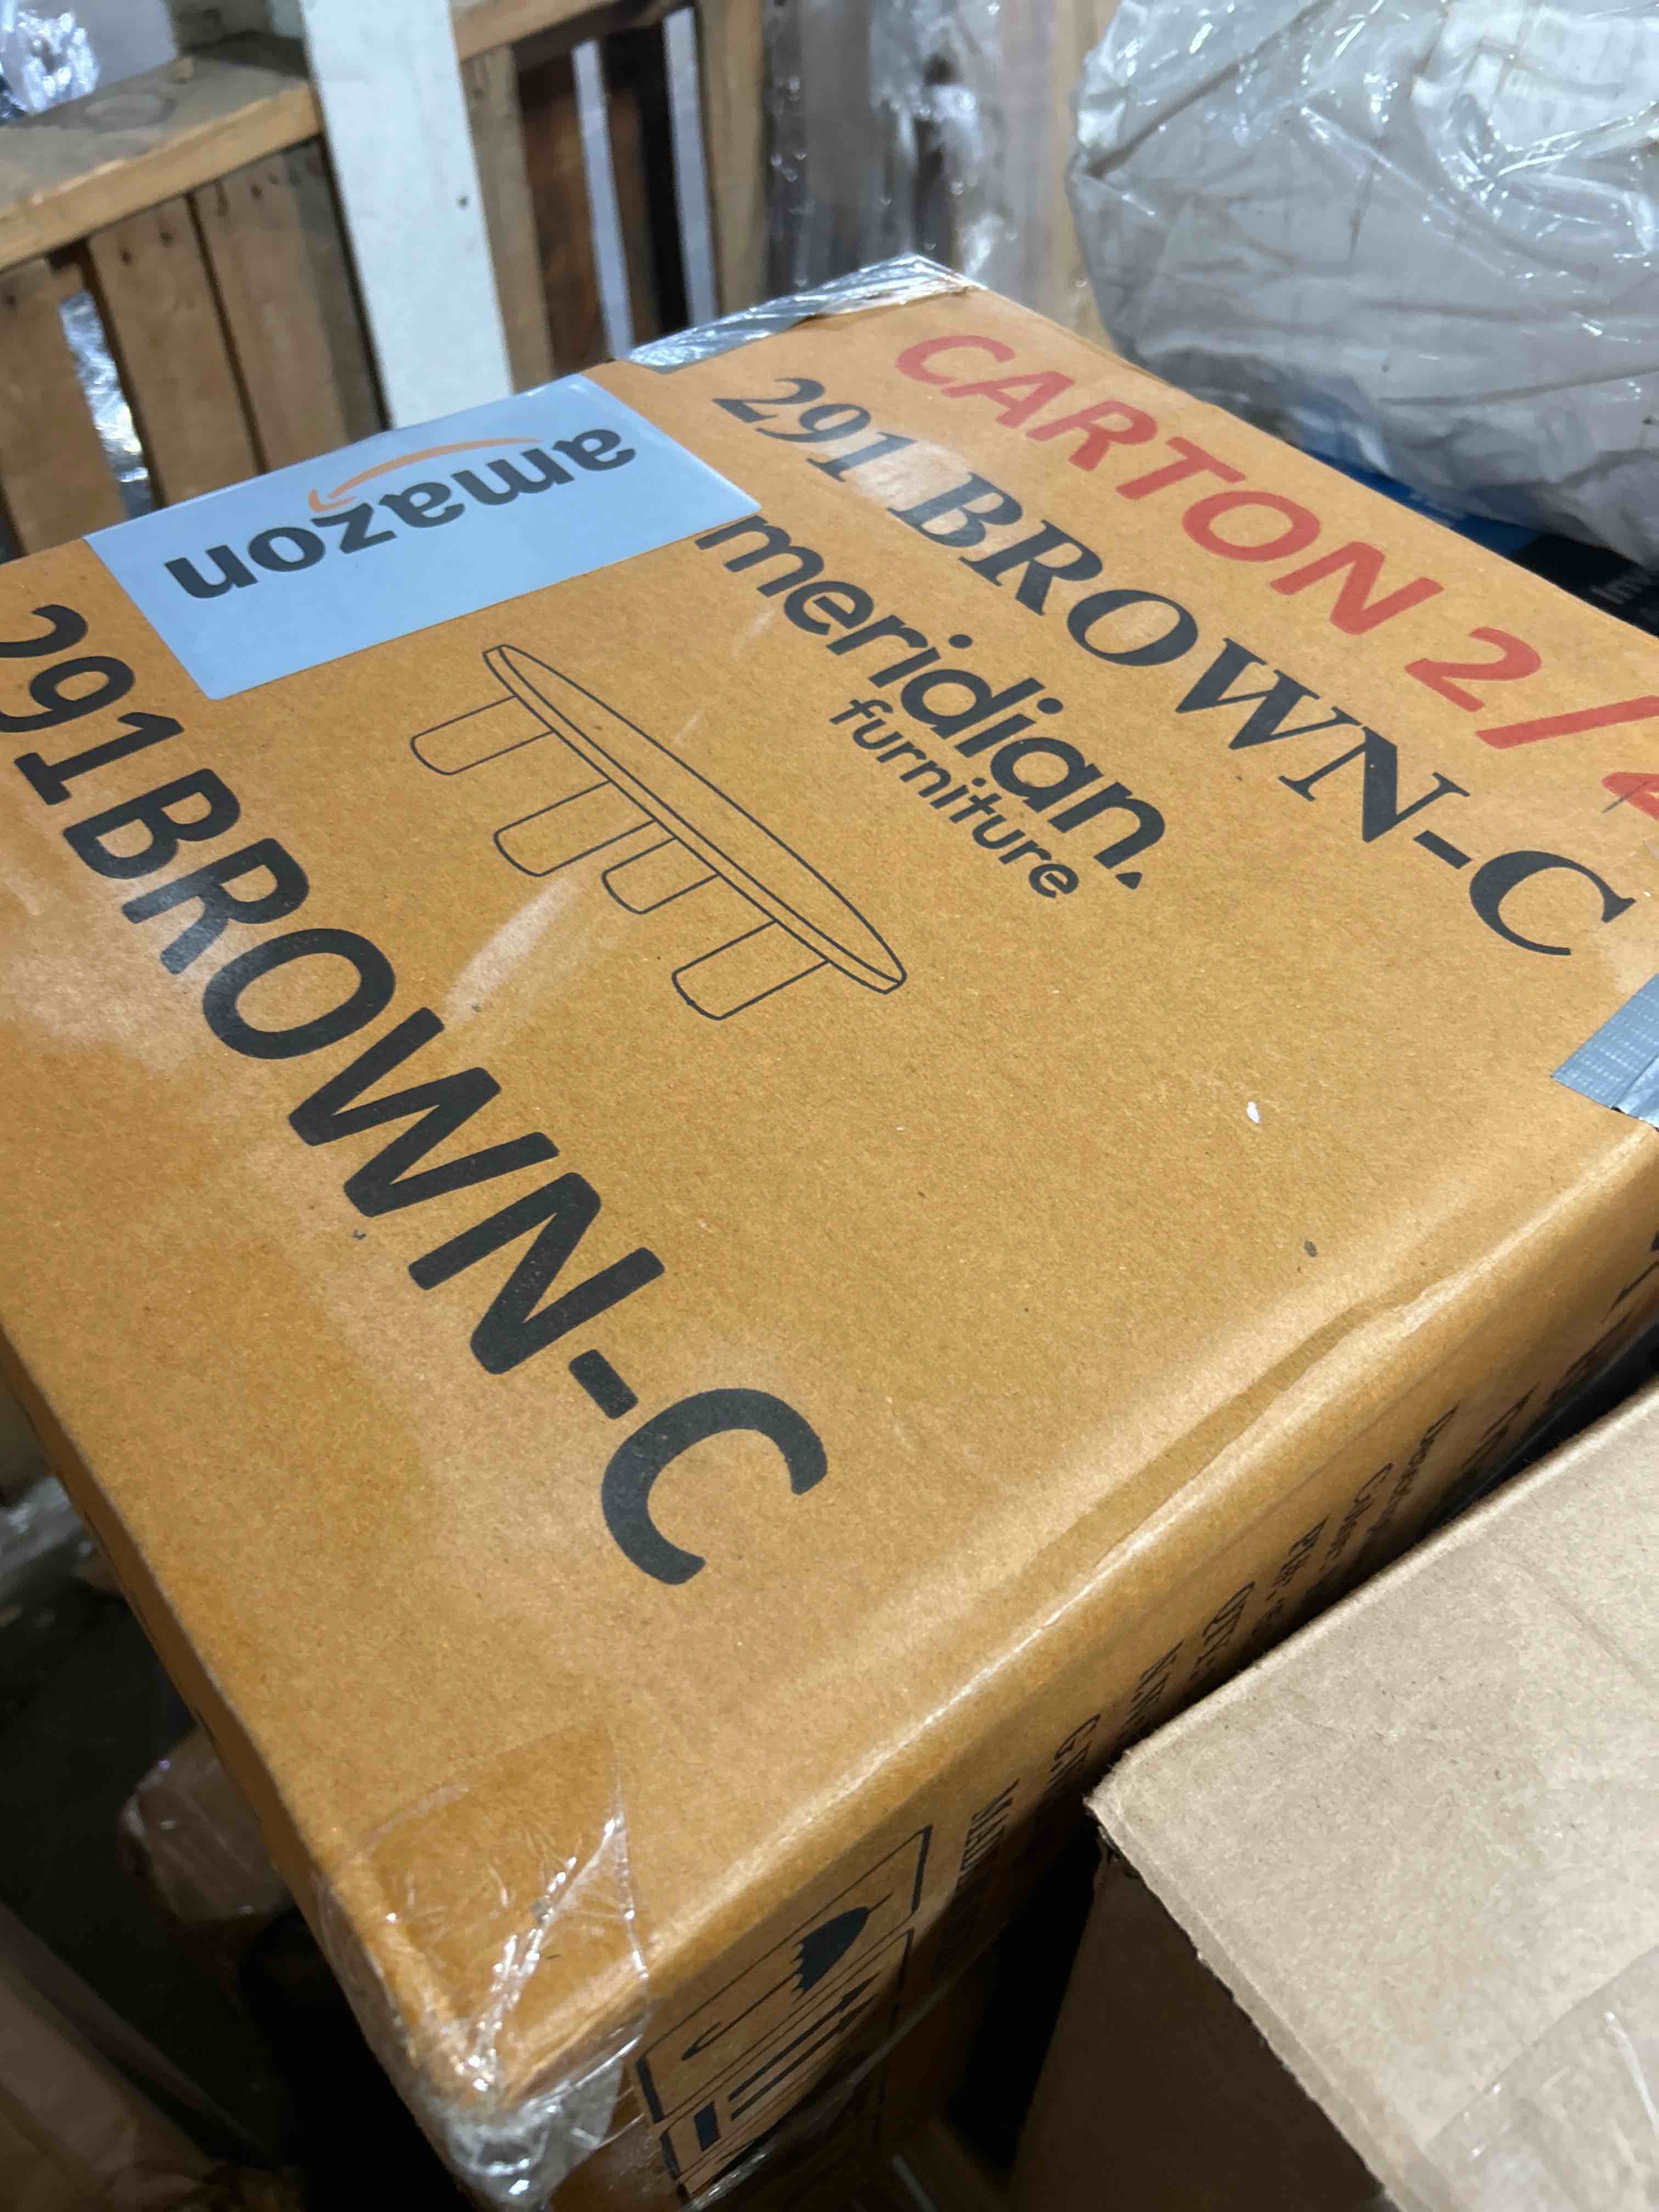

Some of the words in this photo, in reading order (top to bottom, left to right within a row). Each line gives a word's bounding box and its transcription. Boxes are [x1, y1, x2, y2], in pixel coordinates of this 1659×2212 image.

[163, 428, 636, 599] amazon
[894, 334, 1442, 636] CARTON
[694, 515, 1166, 871] meridian
[712, 377, 918, 483] 291
[887, 472, 1637, 956] BROWN-C
[828, 698, 1080, 899] furniture
